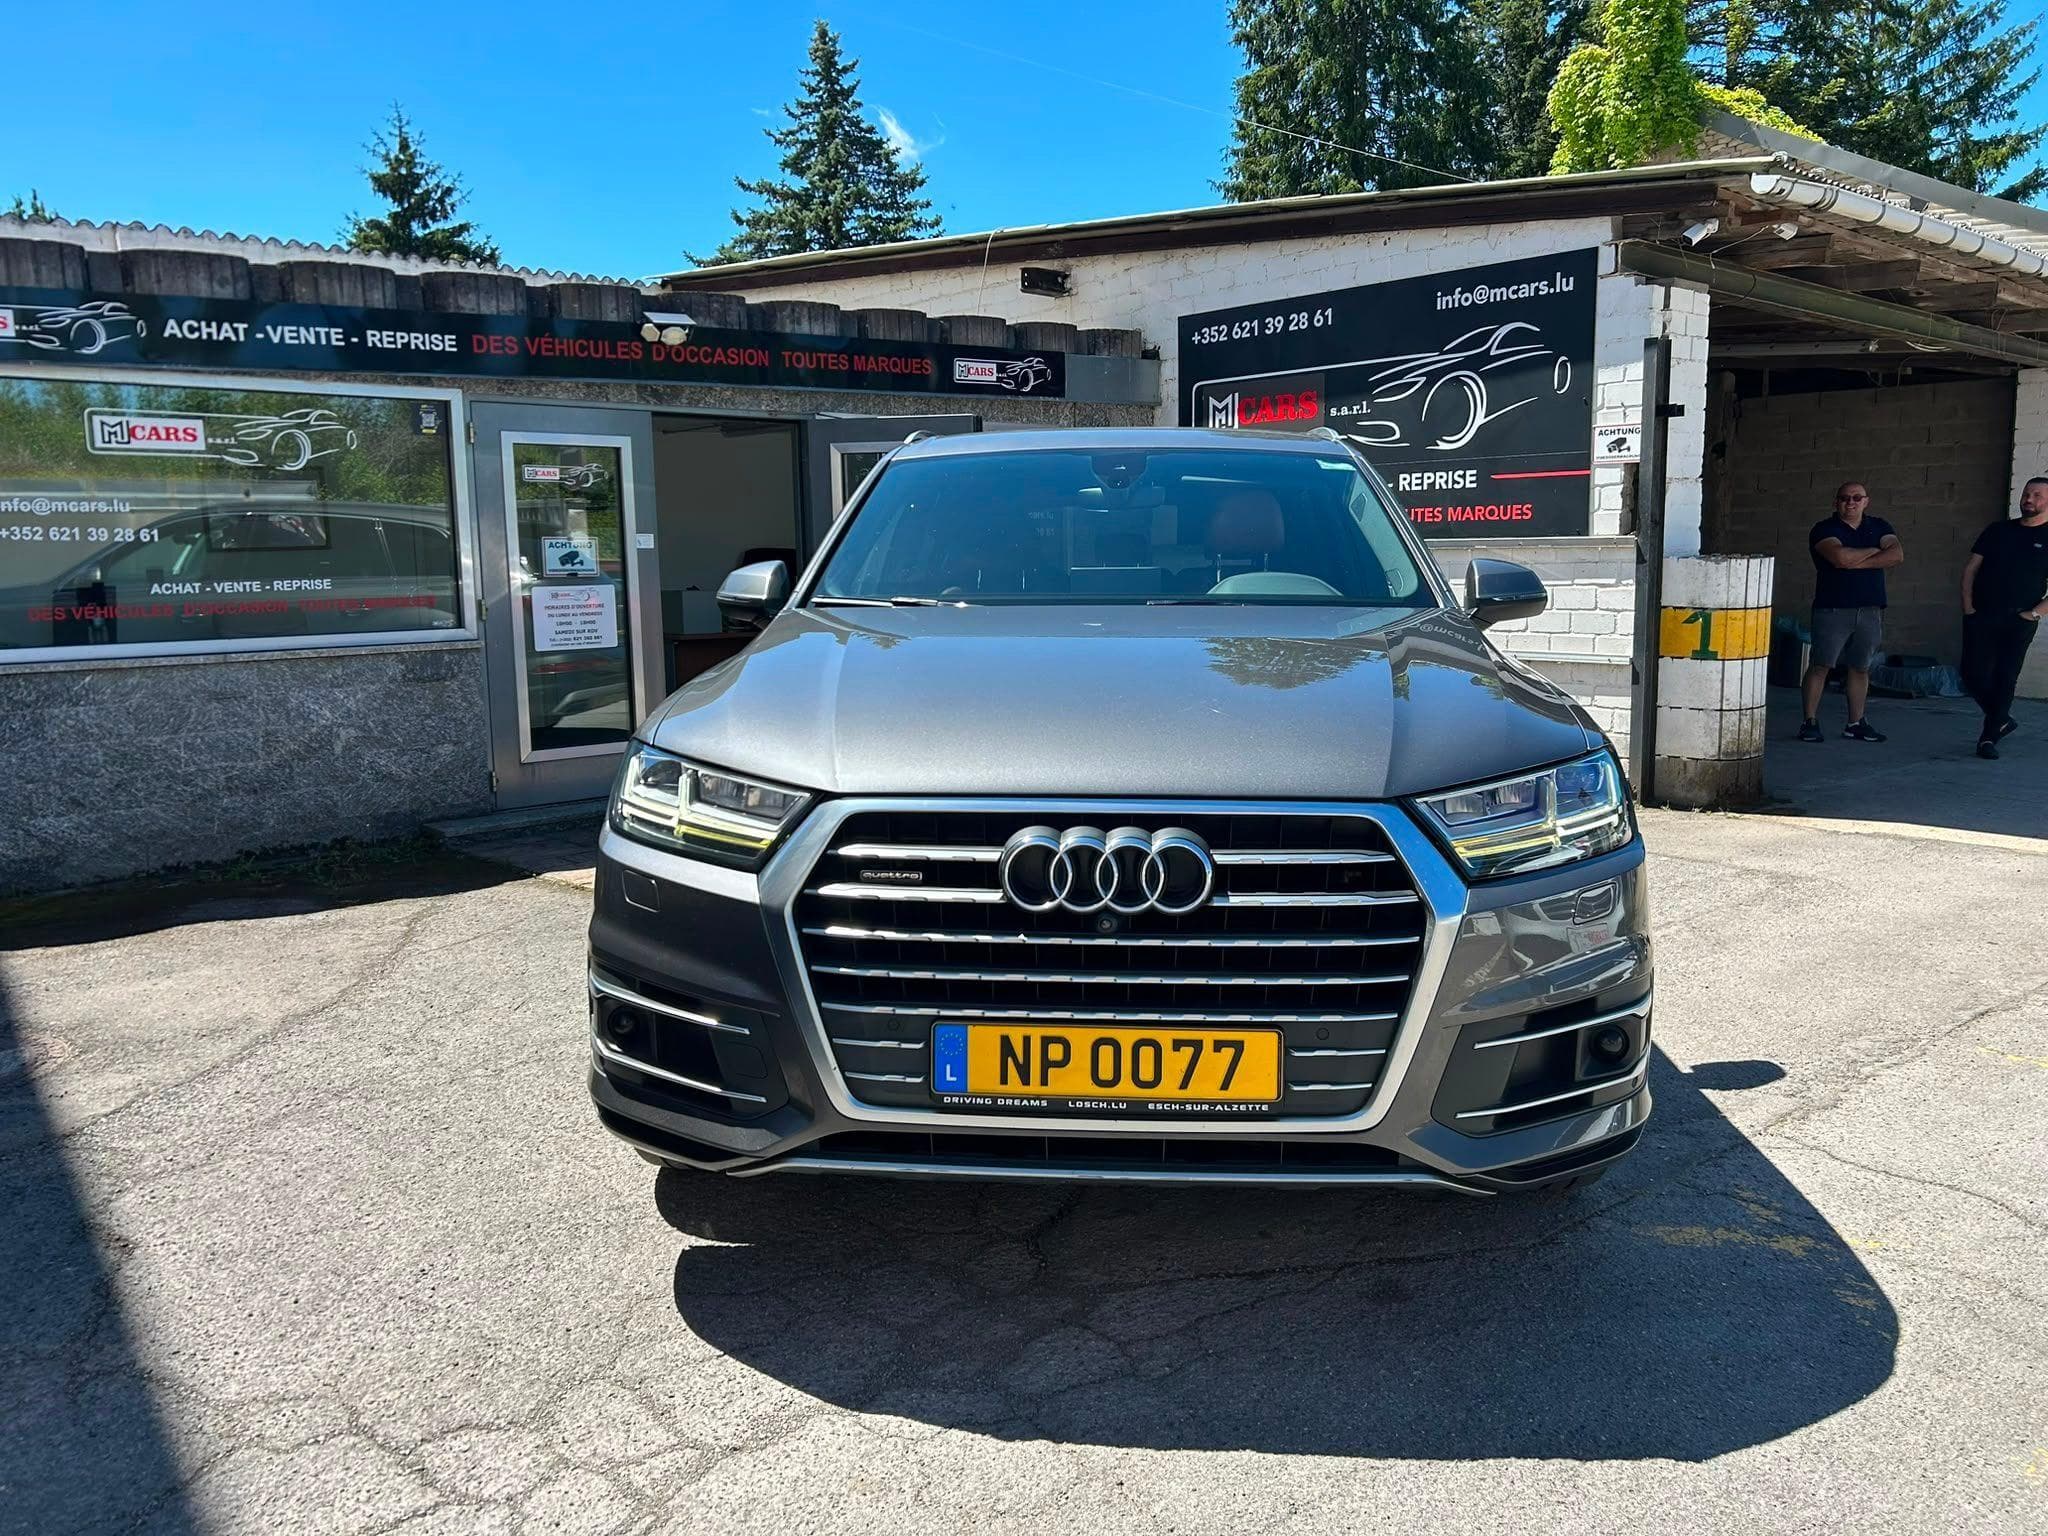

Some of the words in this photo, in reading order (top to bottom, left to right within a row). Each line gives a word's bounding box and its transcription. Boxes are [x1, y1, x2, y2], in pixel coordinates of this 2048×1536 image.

[1436, 271, 1575, 310] info@mcars.lu
[1191, 324, 1228, 345] +352
[1232, 319, 1259, 339] 621
[1264, 315, 1284, 335] 39
[1288, 312, 1309, 331] 28
[1313, 307, 1333, 327] 61
[163, 318, 249, 342] ACHAT
[366, 329, 457, 351] REPRISE
[472, 334, 519, 355] DES
[525, 332, 643, 360] VÉHICULES
[652, 344, 769, 367] D'OCCASION
[782, 351, 849, 371] TOUTES
[853, 355, 932, 375] MARQUES
[1329, 401, 1371, 417] s.a.r.l.
[1598, 427, 1641, 437] ACHTUNG
[1398, 469, 1478, 492] REPRISE
[0, 498, 130, 516] nfo@mcars.lu
[1447, 503, 1533, 521] MARQUES
[0, 527, 43, 541] +352
[49, 526, 80, 541] 621
[87, 527, 109, 542] 39
[113, 528, 135, 542] 28
[139, 528, 159, 542] 61
[150, 583, 201, 595] ACHAT
[213, 581, 262, 593] VENTE
[273, 578, 332, 591] REPRISE
[1681, 610, 1719, 660] 1
[862, 871, 919, 880] quattro
[945, 1063, 957, 1082] L
[999, 1033, 1072, 1087] NP
[1090, 1036, 1246, 1092] 0077
[943, 1096, 992, 1105] DRIVING
[997, 1098, 1048, 1107] DREAMS
[1068, 1100, 1127, 1109] LOSCH.LU
[1147, 1103, 1269, 1111] ESCH-SUR-ALZETTE
